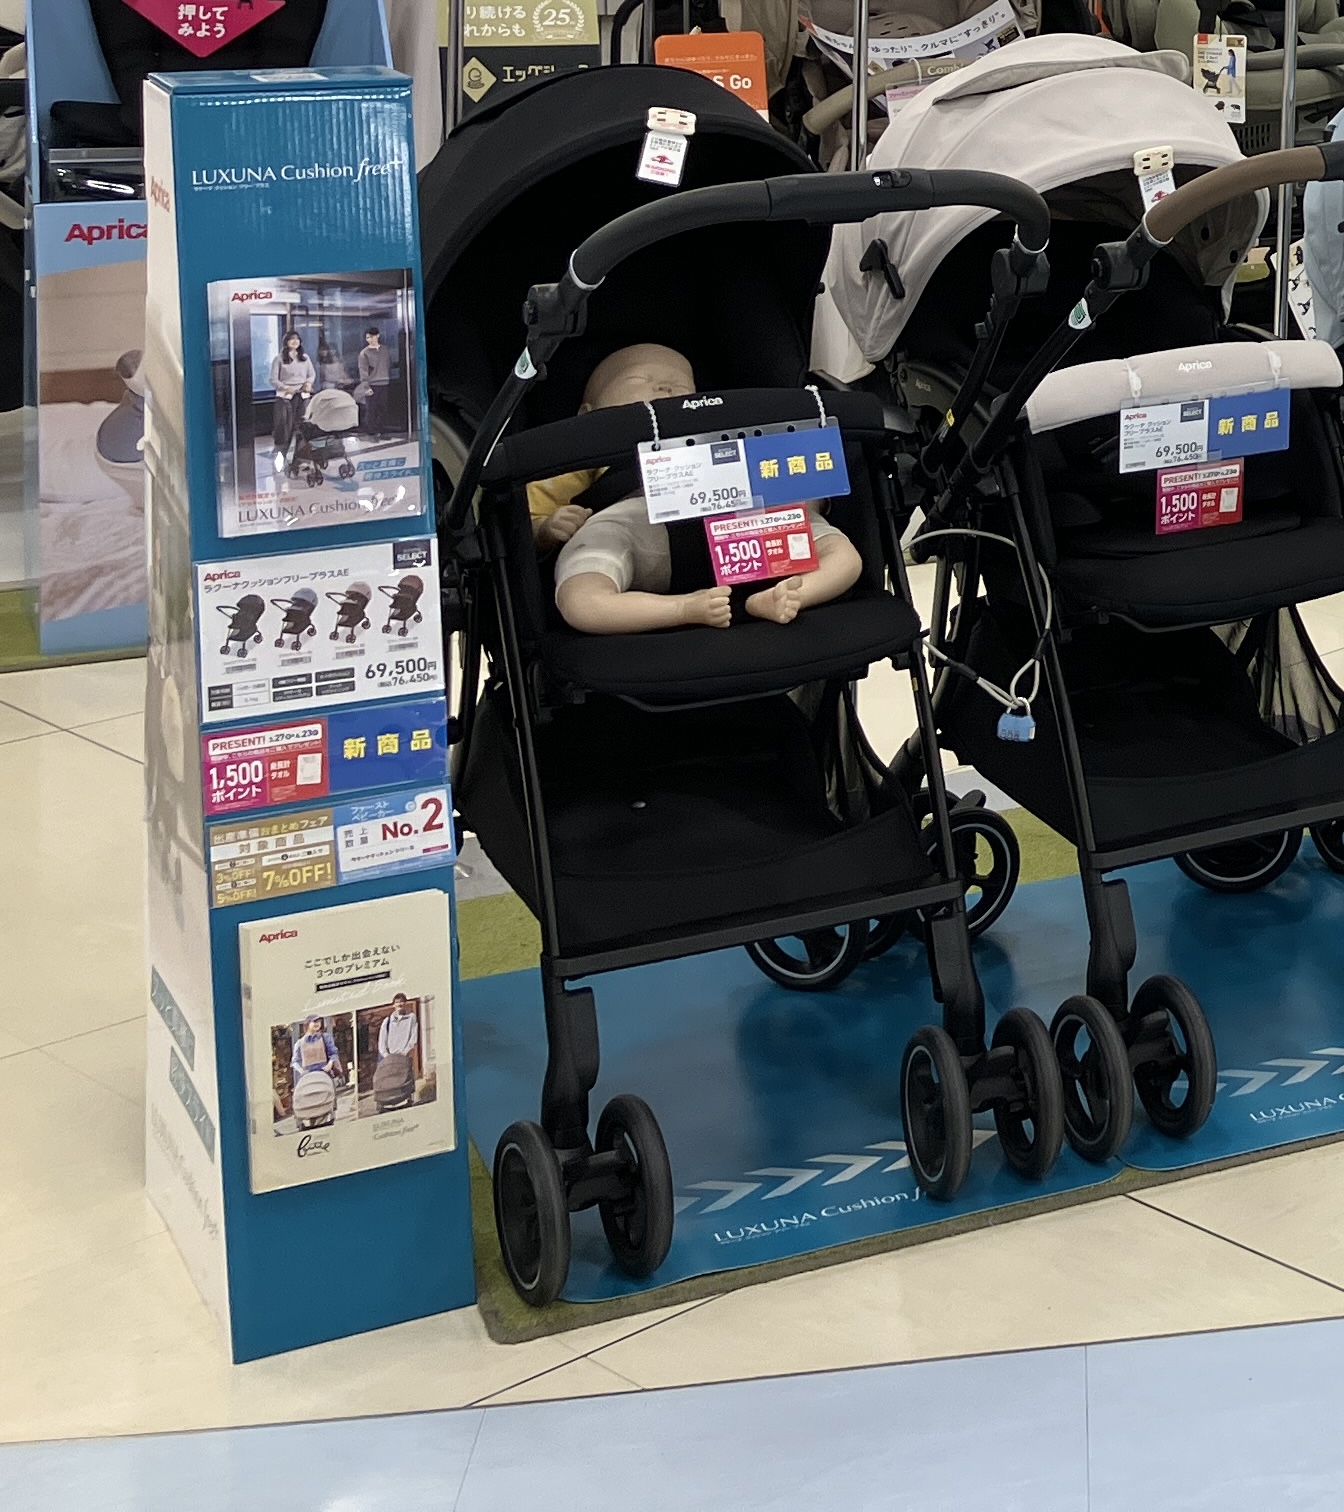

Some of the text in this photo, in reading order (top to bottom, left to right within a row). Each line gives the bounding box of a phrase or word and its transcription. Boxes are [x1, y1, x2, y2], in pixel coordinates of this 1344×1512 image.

[177, 3, 229, 20] 押して
[177, 21, 226, 38] みよう
[729, 74, 752, 90] Go
[192, 163, 354, 186] LUXUNA Cushion
[231, 289, 273, 303] Aprica
[1177, 359, 1213, 372] Aprica
[682, 396, 724, 410] Aprica
[1217, 410, 1280, 436] 新商品
[1155, 441, 1204, 459] 69,500円
[759, 451, 834, 479] 新商品
[689, 487, 747, 506] 69,500円
[1160, 491, 1198, 515] 1,500
[238, 504, 305, 524] LUXUNA
[1160, 511, 1197, 525] ポイント
[713, 519, 759, 533] PRESENT!
[714, 539, 762, 565] 1,500
[719, 560, 763, 576] ポイント
[365, 657, 438, 680] 69,500円
[211, 735, 265, 752] PRESENT!
[343, 728, 433, 761] 新商品
[209, 760, 263, 790] 1,500
[211, 784, 262, 804] ポイント
[351, 800, 390, 815] ファースト
[351, 808, 395, 822] ベビーカー
[381, 797, 445, 841] No.2
[213, 815, 329, 844] 出産準備おまとめフェア
[238, 832, 306, 855] 対象商品
[262, 860, 333, 892] 7%OFF!
[258, 928, 299, 944] Aprica
[303, 944, 401, 970] ここでしか出会えない
[316, 958, 390, 979] 3つのプレミアム
[1248, 1093, 1336, 1122] LUXUNA
[713, 1211, 818, 1243] LUXUNA
[820, 1191, 910, 1219] Cushion
